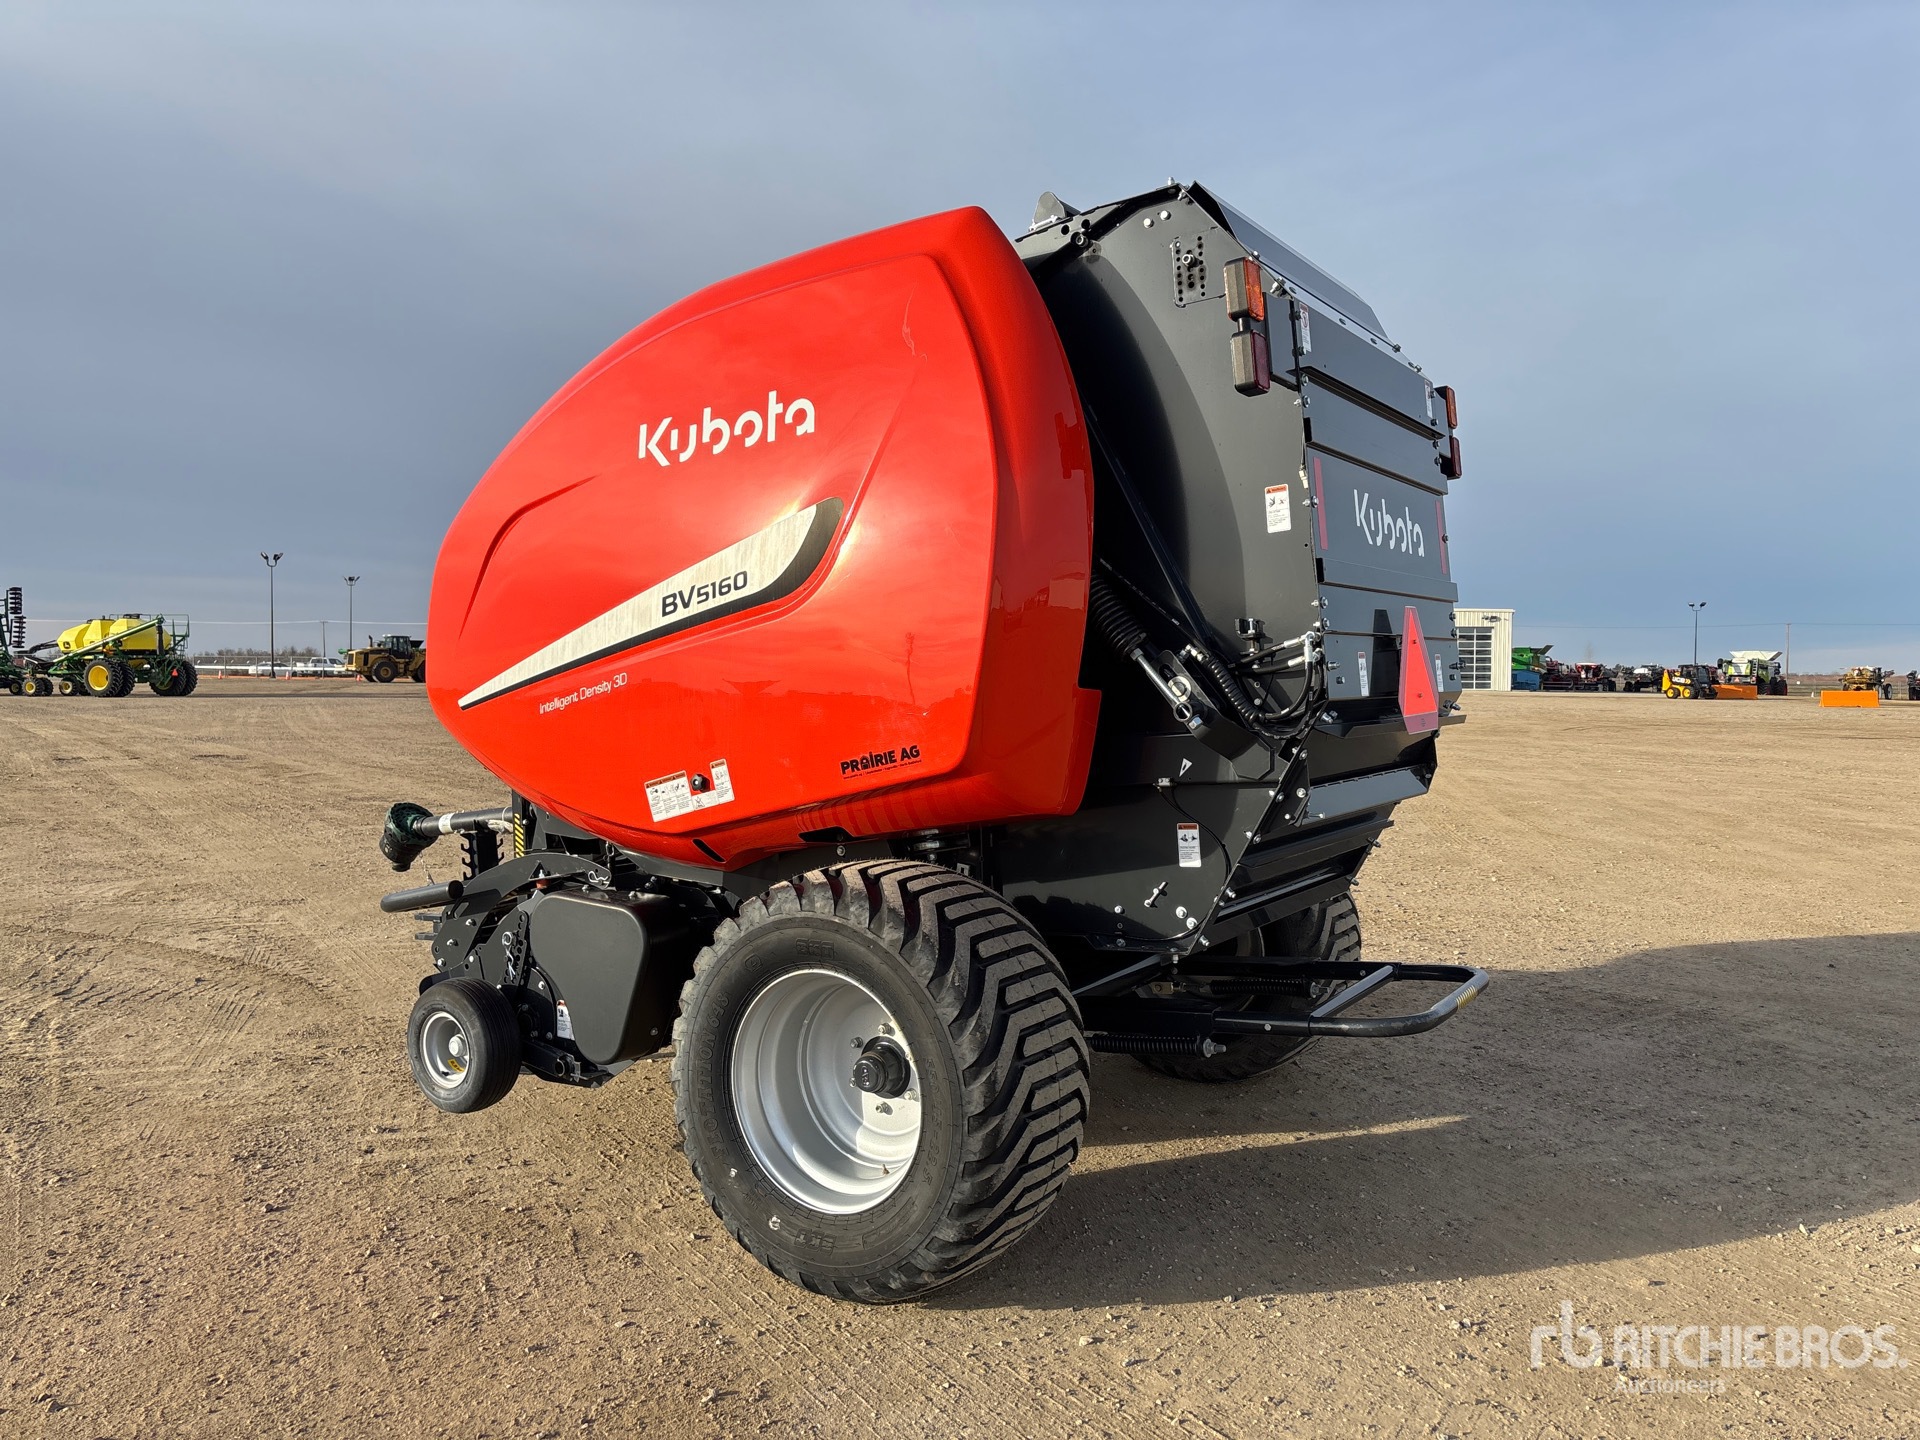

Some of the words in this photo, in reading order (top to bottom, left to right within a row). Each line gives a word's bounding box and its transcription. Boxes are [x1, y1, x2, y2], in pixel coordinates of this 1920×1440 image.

[638, 390, 815, 467] Kubota
[1354, 489, 1425, 557] Kubota
[662, 570, 748, 617] BV5160
[539, 692, 578, 715] Intelligent
[580, 680, 612, 701] Density
[613, 672, 628, 688] 3D
[901, 745, 920, 761] AG
[697, 1029, 730, 1159] FLOTATION
